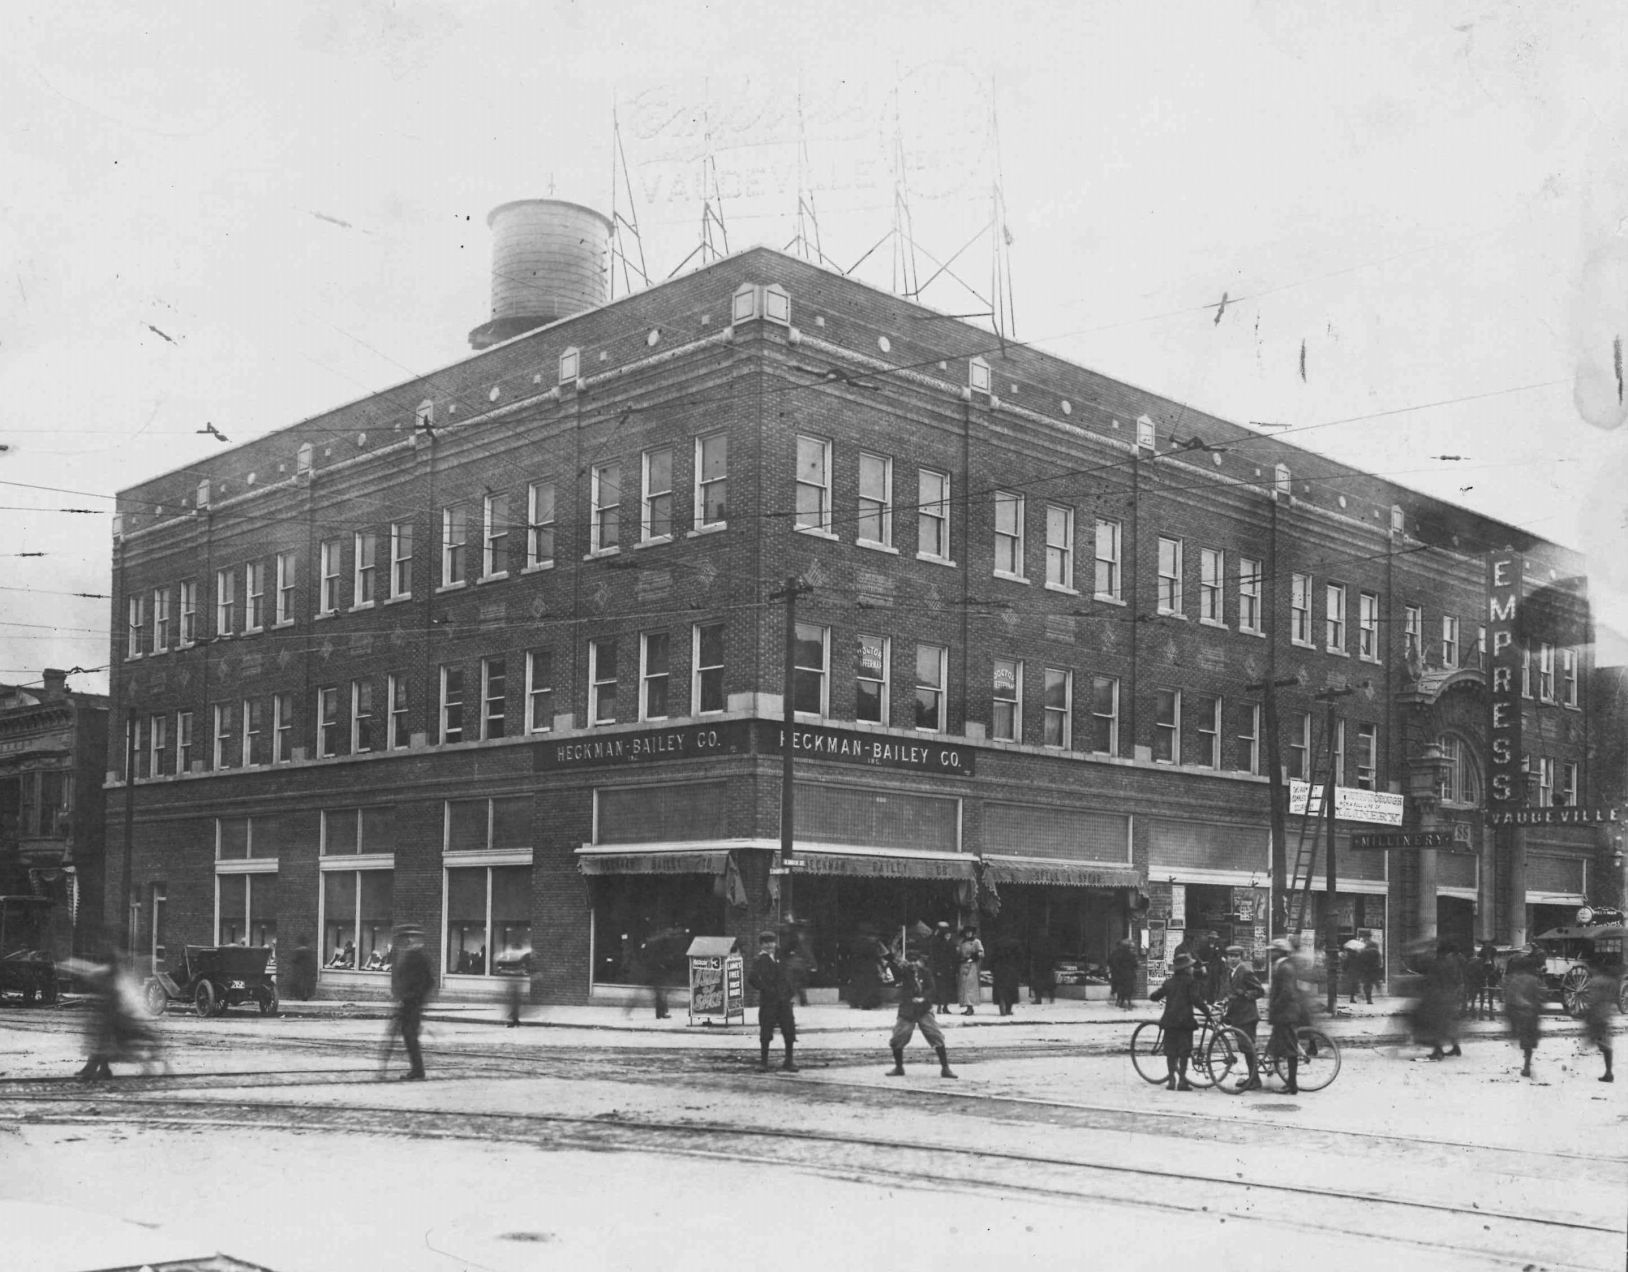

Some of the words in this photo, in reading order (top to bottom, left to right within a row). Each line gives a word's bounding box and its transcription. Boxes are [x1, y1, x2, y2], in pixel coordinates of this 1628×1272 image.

[1490, 559, 1516, 800] EMPRESS
[557, 734, 685, 761] HECKMAN-BAILEY
[697, 731, 721, 748] CO.
[941, 751, 961, 767] CO.
[1492, 808, 1618, 824] VAUDEVILLE
